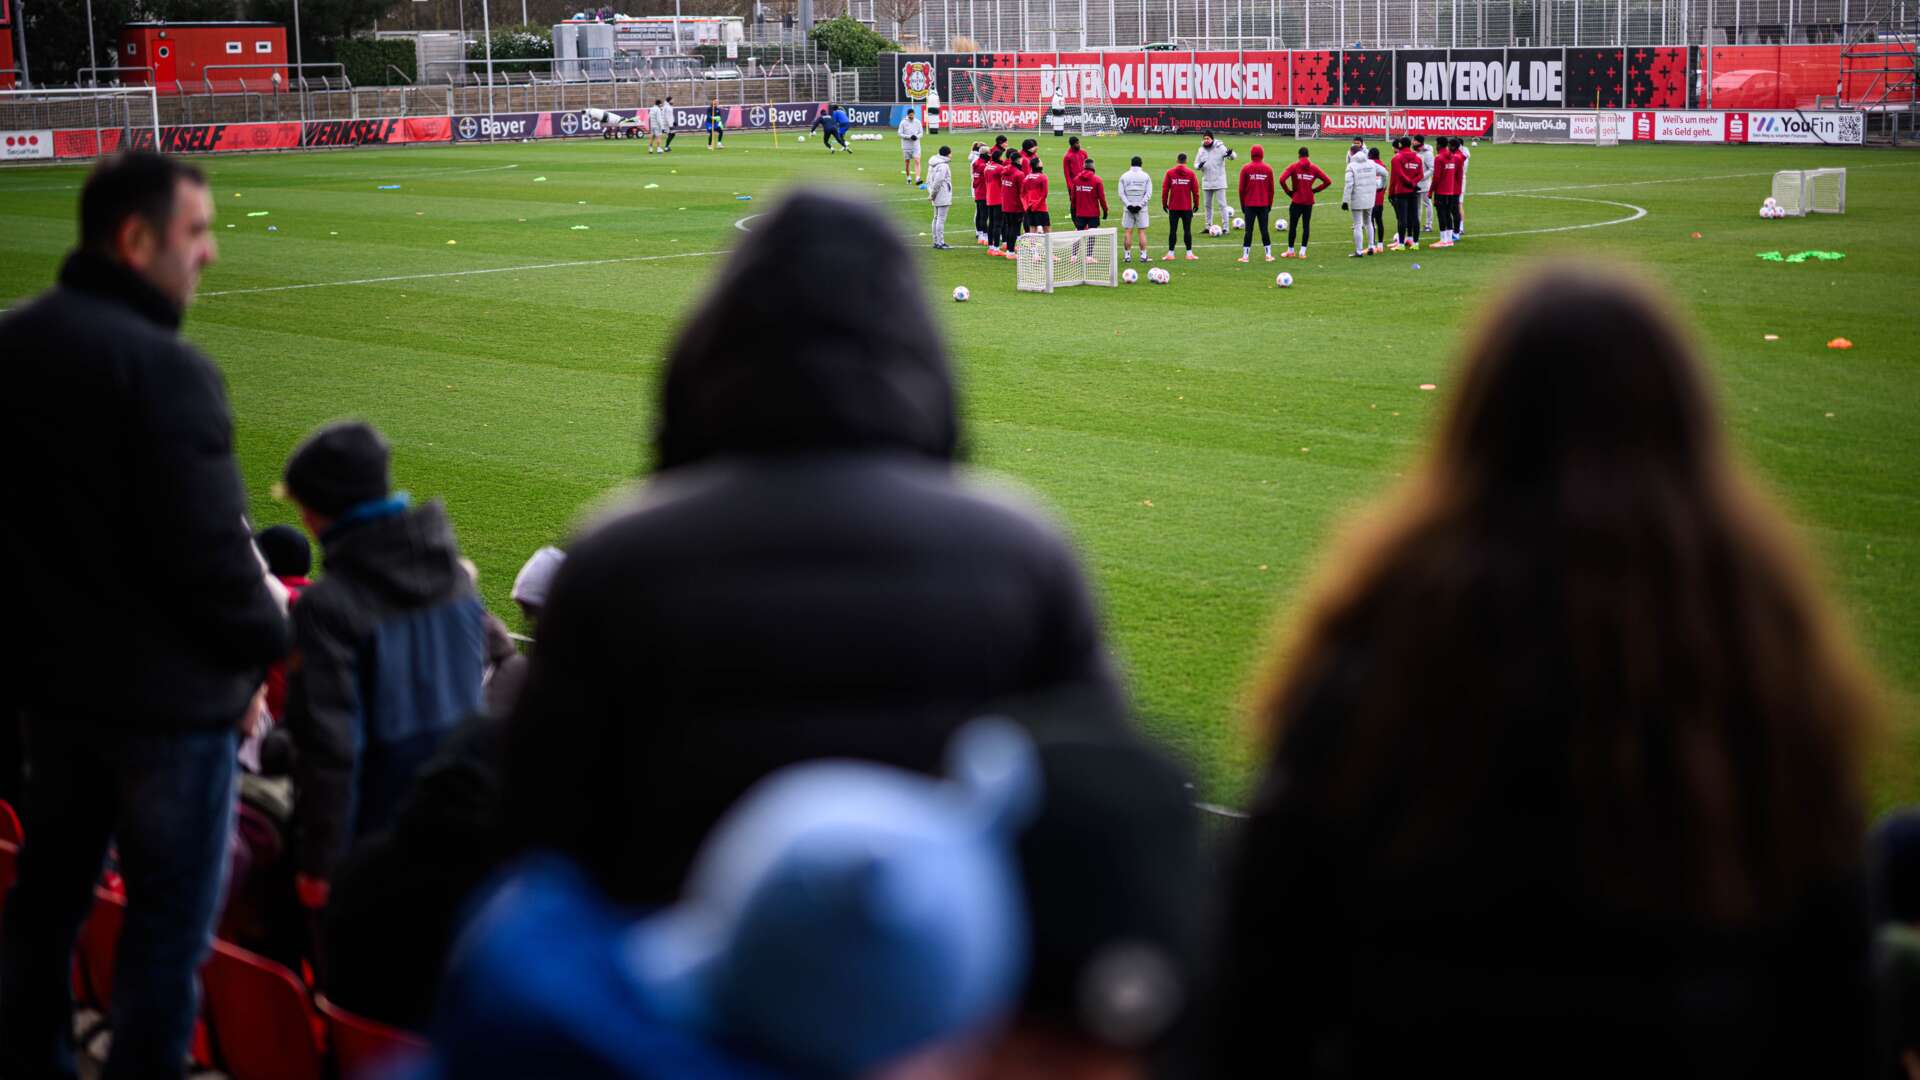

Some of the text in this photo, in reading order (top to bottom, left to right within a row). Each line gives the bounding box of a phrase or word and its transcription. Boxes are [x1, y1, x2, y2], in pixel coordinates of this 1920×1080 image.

[1040, 63, 1273, 99] BAYER 04 LEVERKUSEN
[1407, 61, 1562, 101] BAYER04.DE
[676, 110, 708, 131] Bay
[769, 106, 808, 130] Bayer
[849, 107, 880, 128] Bayer
[1232, 118, 1261, 129] Events
[1324, 115, 1488, 131] ALLES RUND UM DIE WERKSELF
[1662, 115, 1684, 123] Weil's
[1698, 116, 1718, 124] mehr
[1781, 117, 1834, 133] YouFin
[298, 116, 399, 147] WERKSELF
[480, 116, 526, 141] Bayer
[1662, 128, 1713, 138] als Geld geht.
